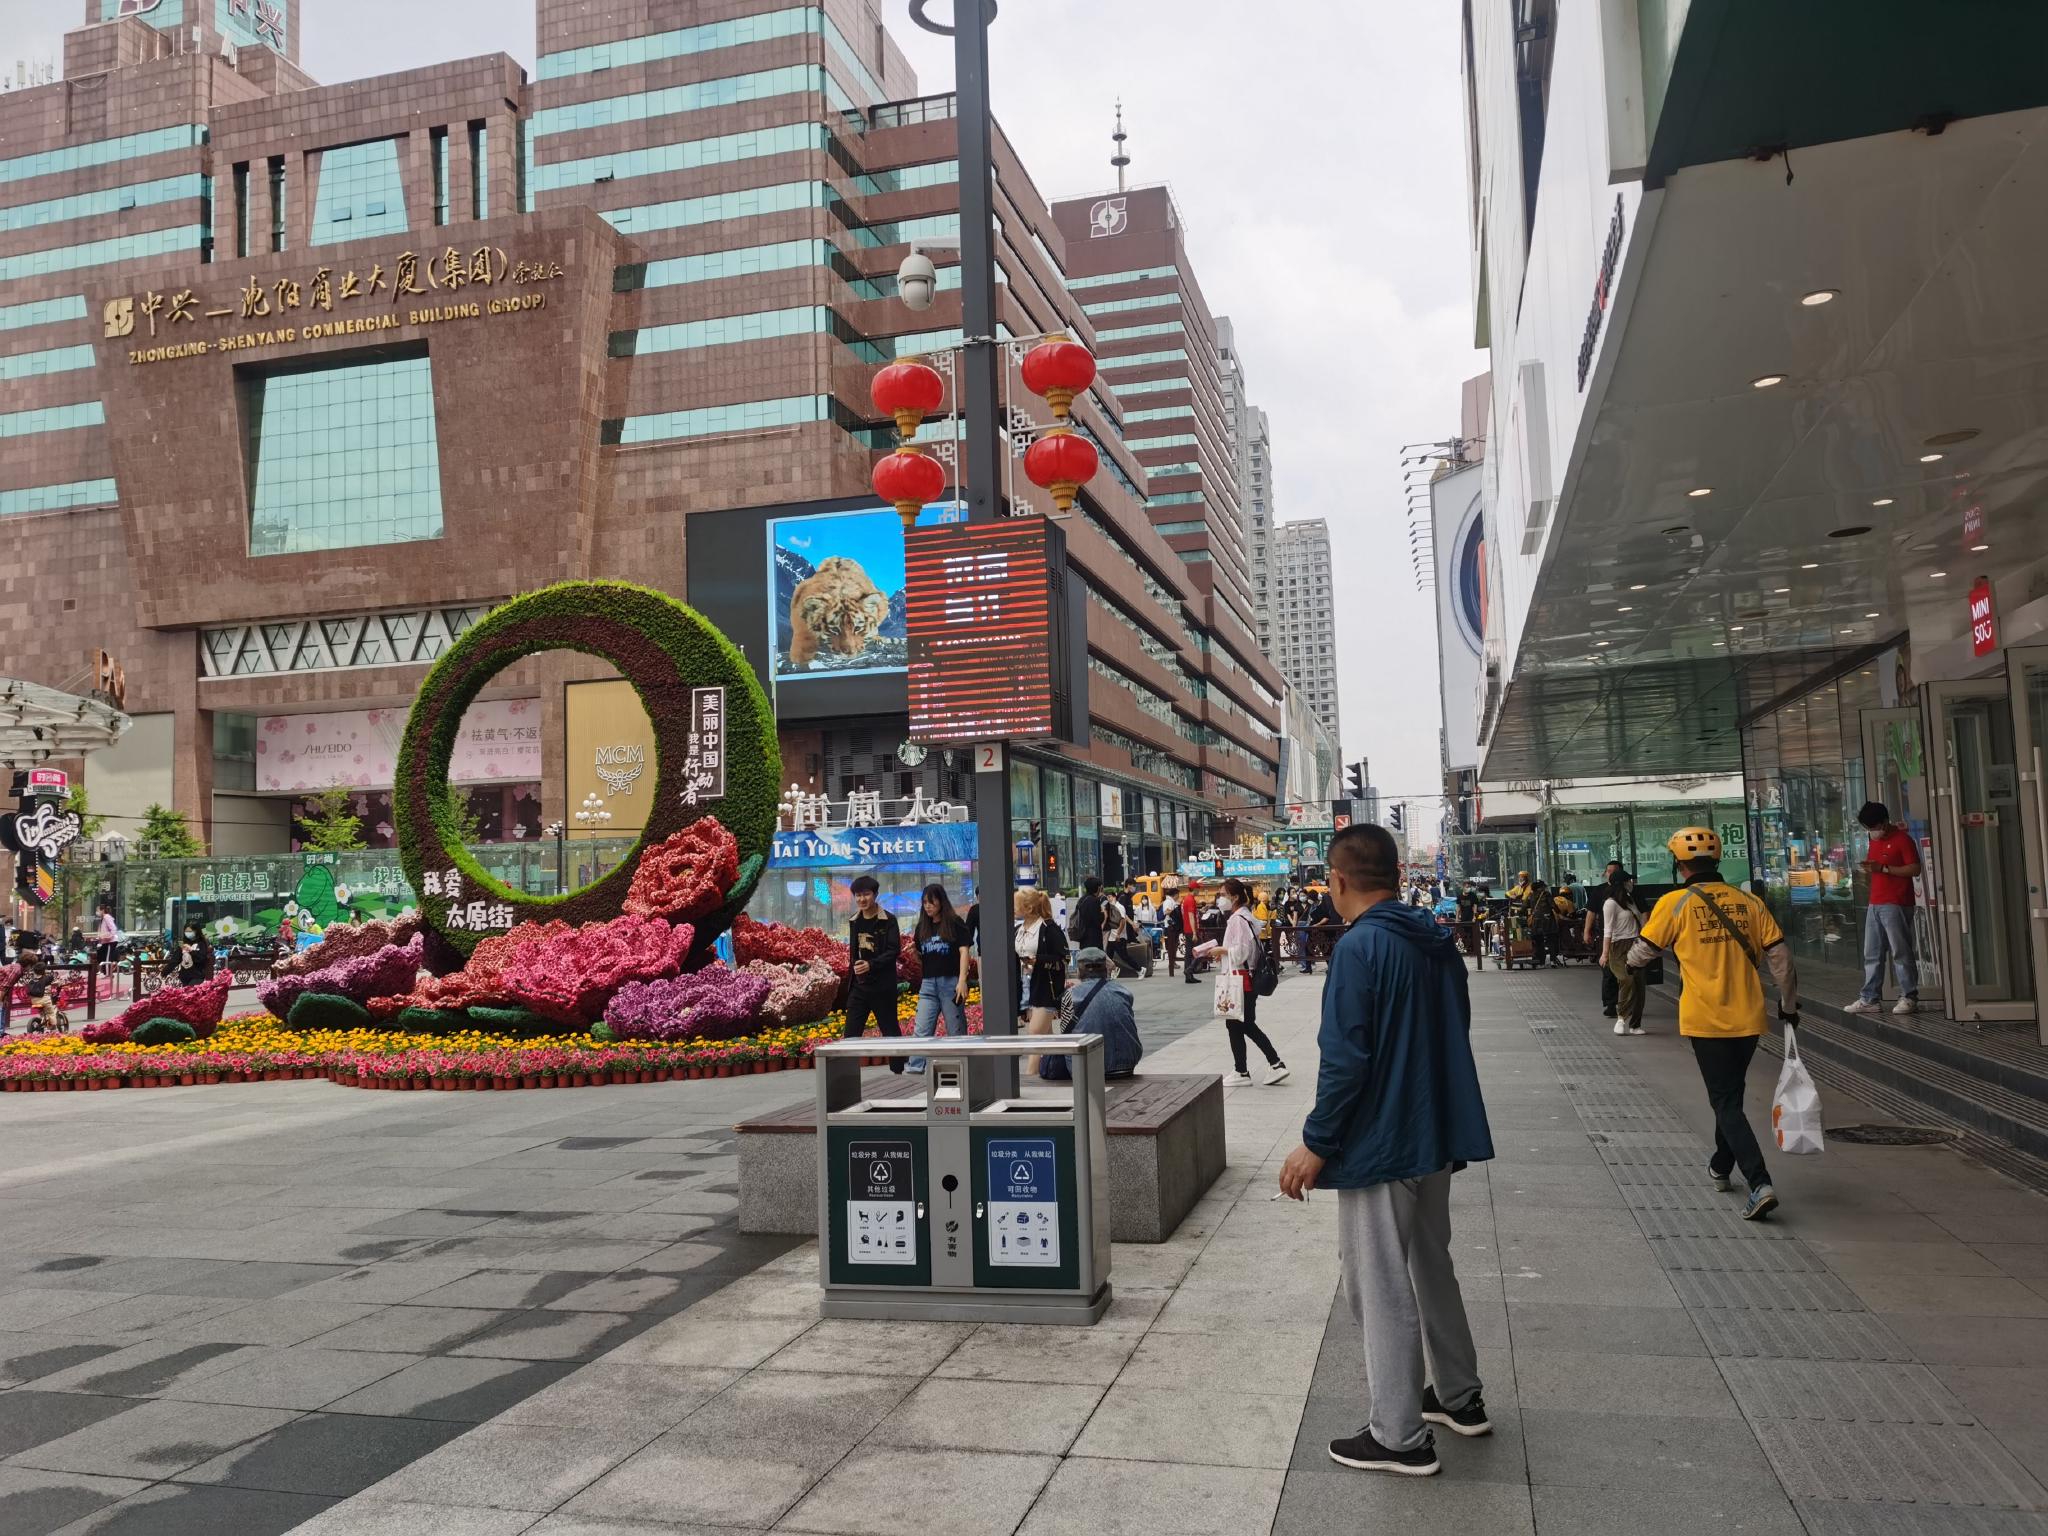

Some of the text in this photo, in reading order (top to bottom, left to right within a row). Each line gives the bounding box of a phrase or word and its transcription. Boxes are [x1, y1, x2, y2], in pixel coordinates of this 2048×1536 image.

[302, 313, 401, 339] COMMERCIAL
[409, 302, 481, 326] BUILDING
[487, 292, 546, 316] (GROUP)
[1971, 597, 1990, 622] MINI
[471, 726, 541, 742] 祛黄气·不返
[702, 694, 719, 769] 美丽中国
[301, 743, 352, 755] SHISEIDO
[595, 744, 645, 765] MCM
[983, 747, 994, 767] 2
[1721, 824, 1746, 845] 抱
[200, 872, 269, 891] 抱住绿马
[423, 868, 461, 898] 我爱
[446, 900, 514, 931] 太原街
[851, 1151, 910, 1159] 垃圾分类 从我做起
[991, 1150, 1052, 1158] 垃圾分类 从我做起
[867, 1185, 896, 1193] 其他垃圾
[1007, 1185, 1038, 1194] 可回收物
